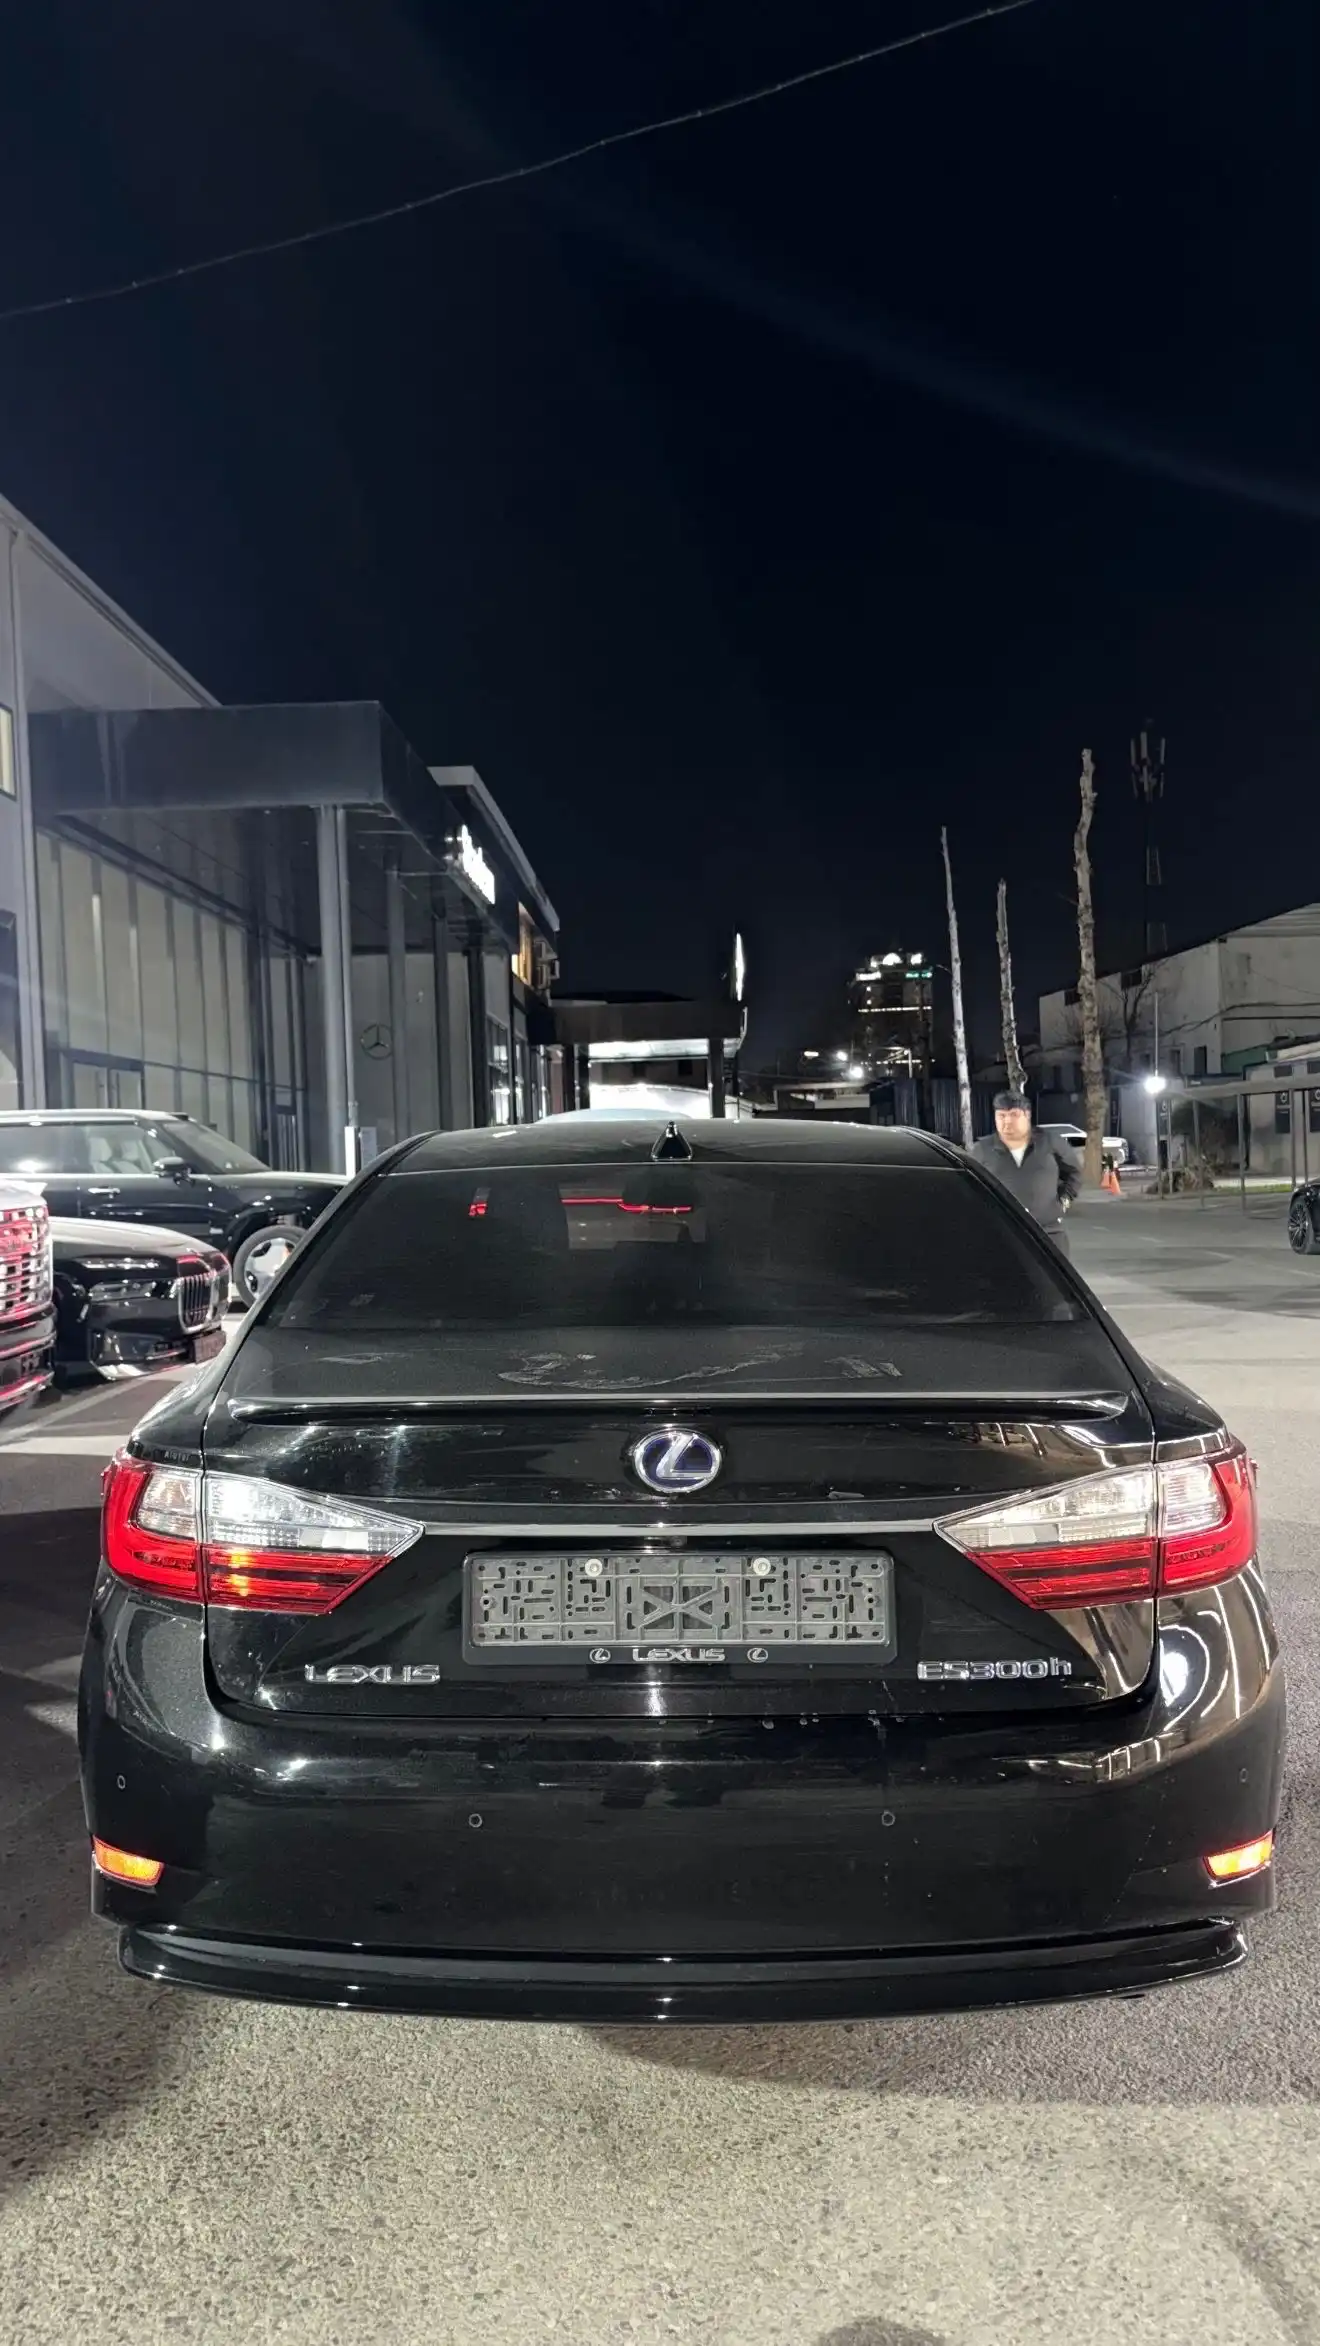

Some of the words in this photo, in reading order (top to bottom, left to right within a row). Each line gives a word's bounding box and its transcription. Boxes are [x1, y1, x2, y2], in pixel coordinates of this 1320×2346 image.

[632, 1648, 726, 1662] LEXUS
[304, 1664, 441, 1685] LEXUS
[917, 1656, 1073, 1681] ES300h
